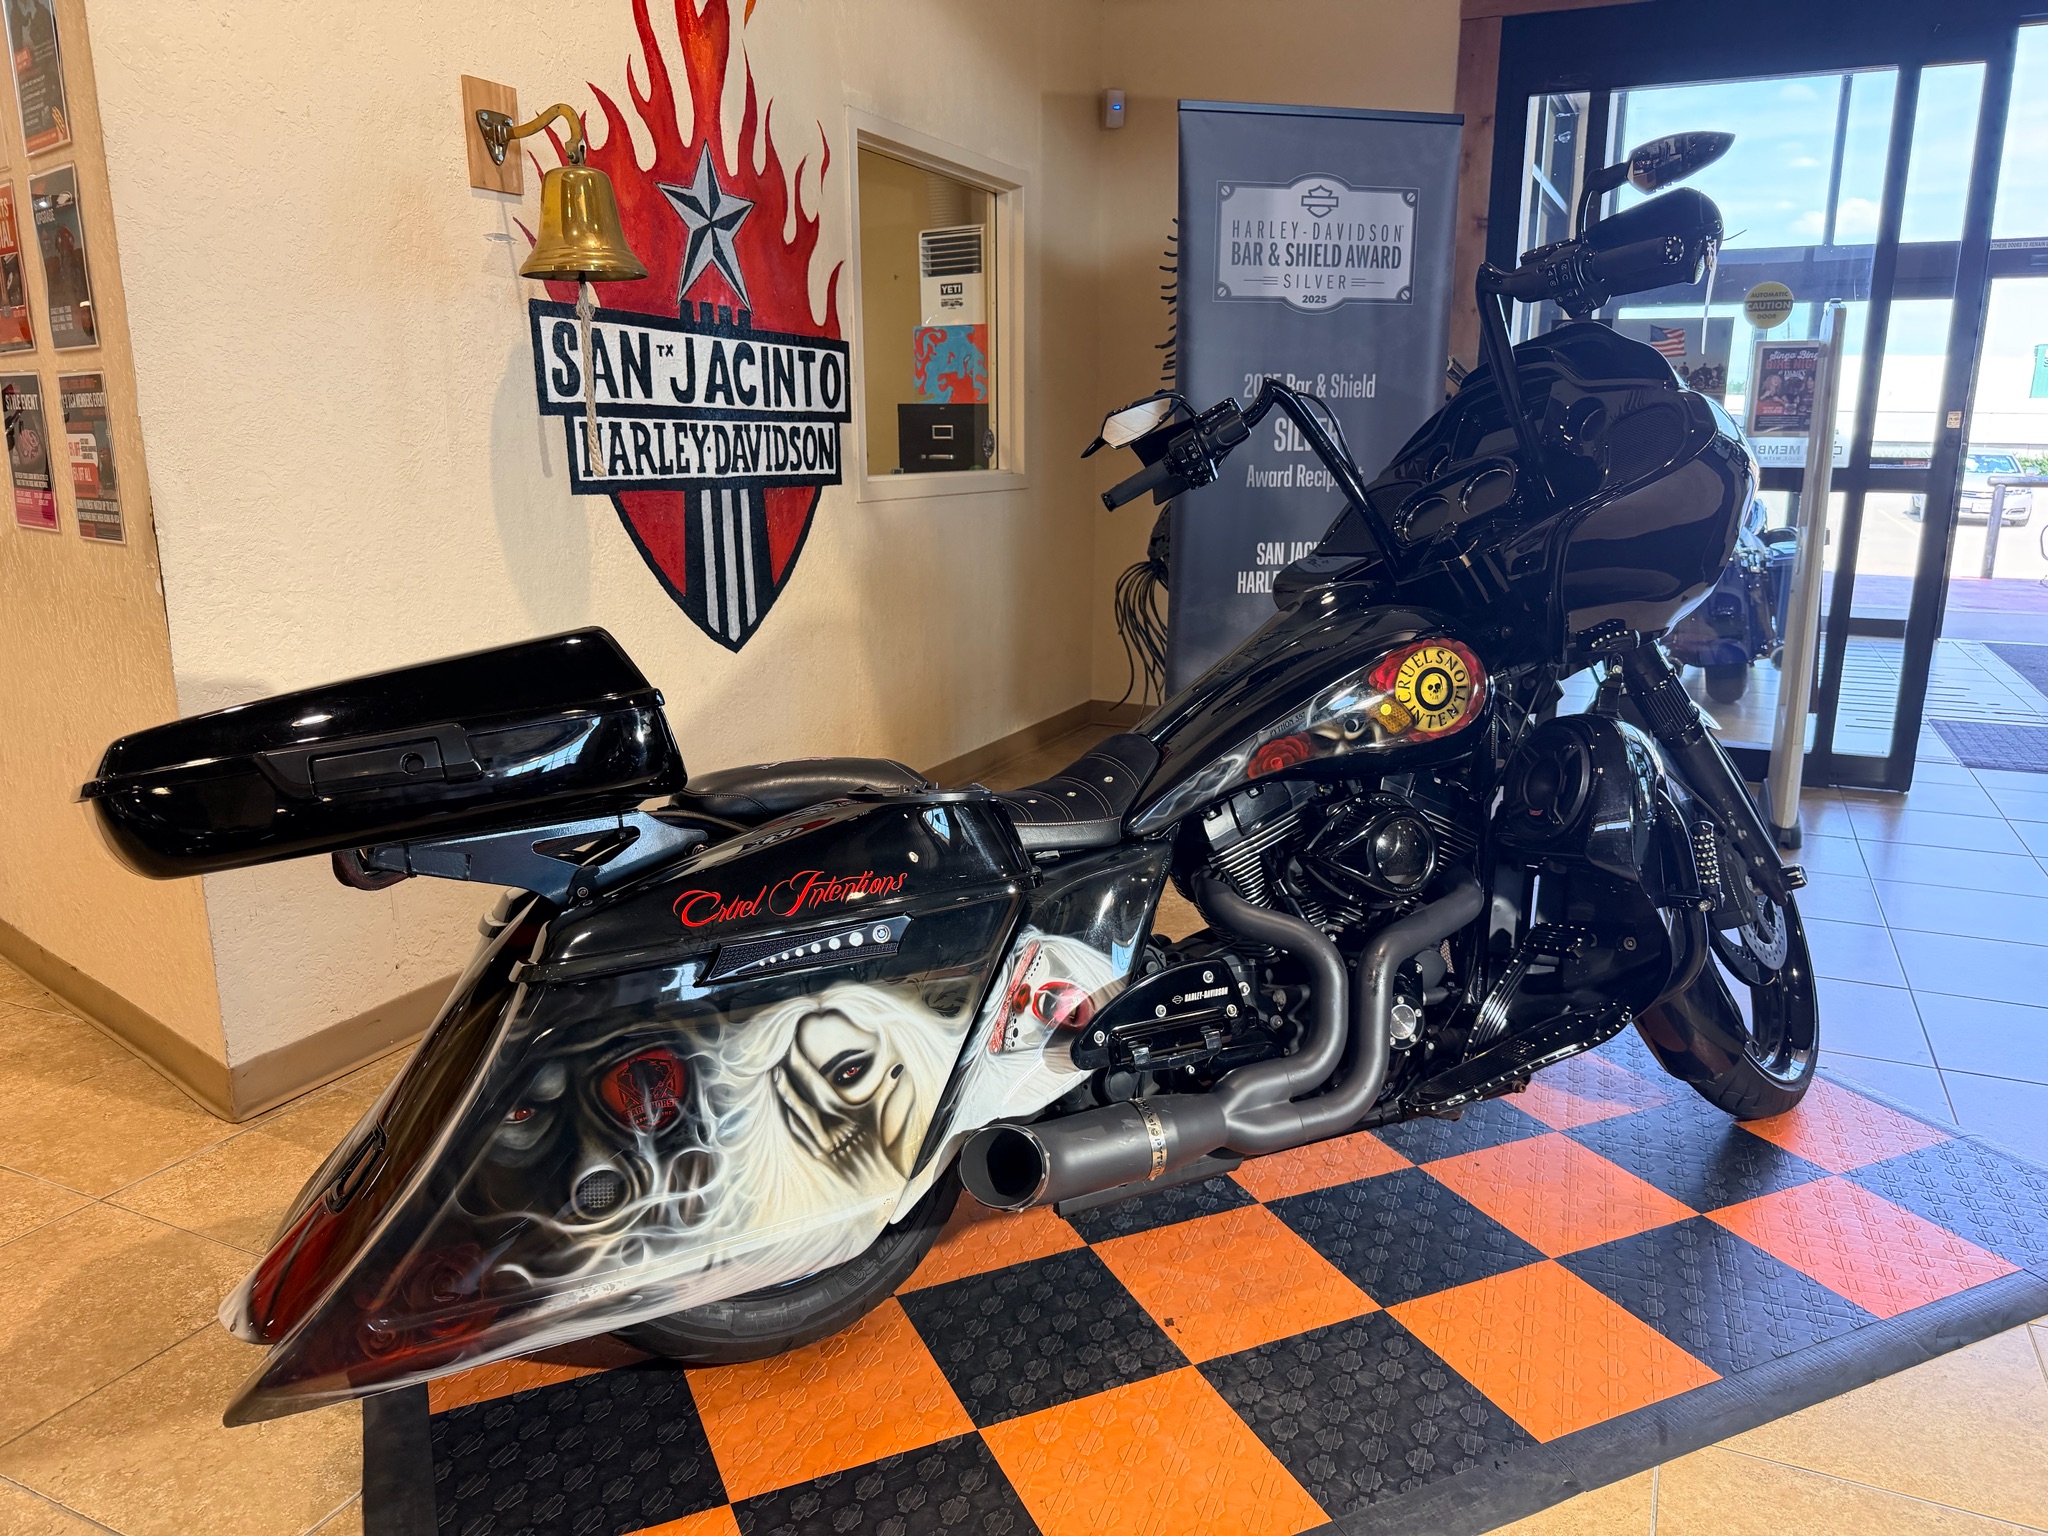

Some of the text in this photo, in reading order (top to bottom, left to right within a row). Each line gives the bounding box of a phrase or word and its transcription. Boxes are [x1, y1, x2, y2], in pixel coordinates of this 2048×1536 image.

[1232, 219, 1402, 242] HARLEY-DAVIDSON
[1231, 241, 1402, 269] BAR & SHIELD AWARD
[941, 284, 961, 294] YETI
[1283, 273, 1347, 290] SILVER
[1302, 294, 1328, 304] 2025
[1747, 301, 1791, 310] CAUTION
[552, 320, 841, 409] SAN TX JACINTO
[1794, 358, 1816, 369] NIG
[1797, 350, 1818, 361] Bing
[1316, 373, 1326, 398] &
[1331, 373, 1376, 398] Shield
[20, 393, 38, 411] EVENT
[1247, 463, 1293, 488] Award
[1256, 542, 1285, 566] SAN
[1270, 718, 1294, 737] PYTHON
[673, 870, 908, 928] Cruel Intentions
